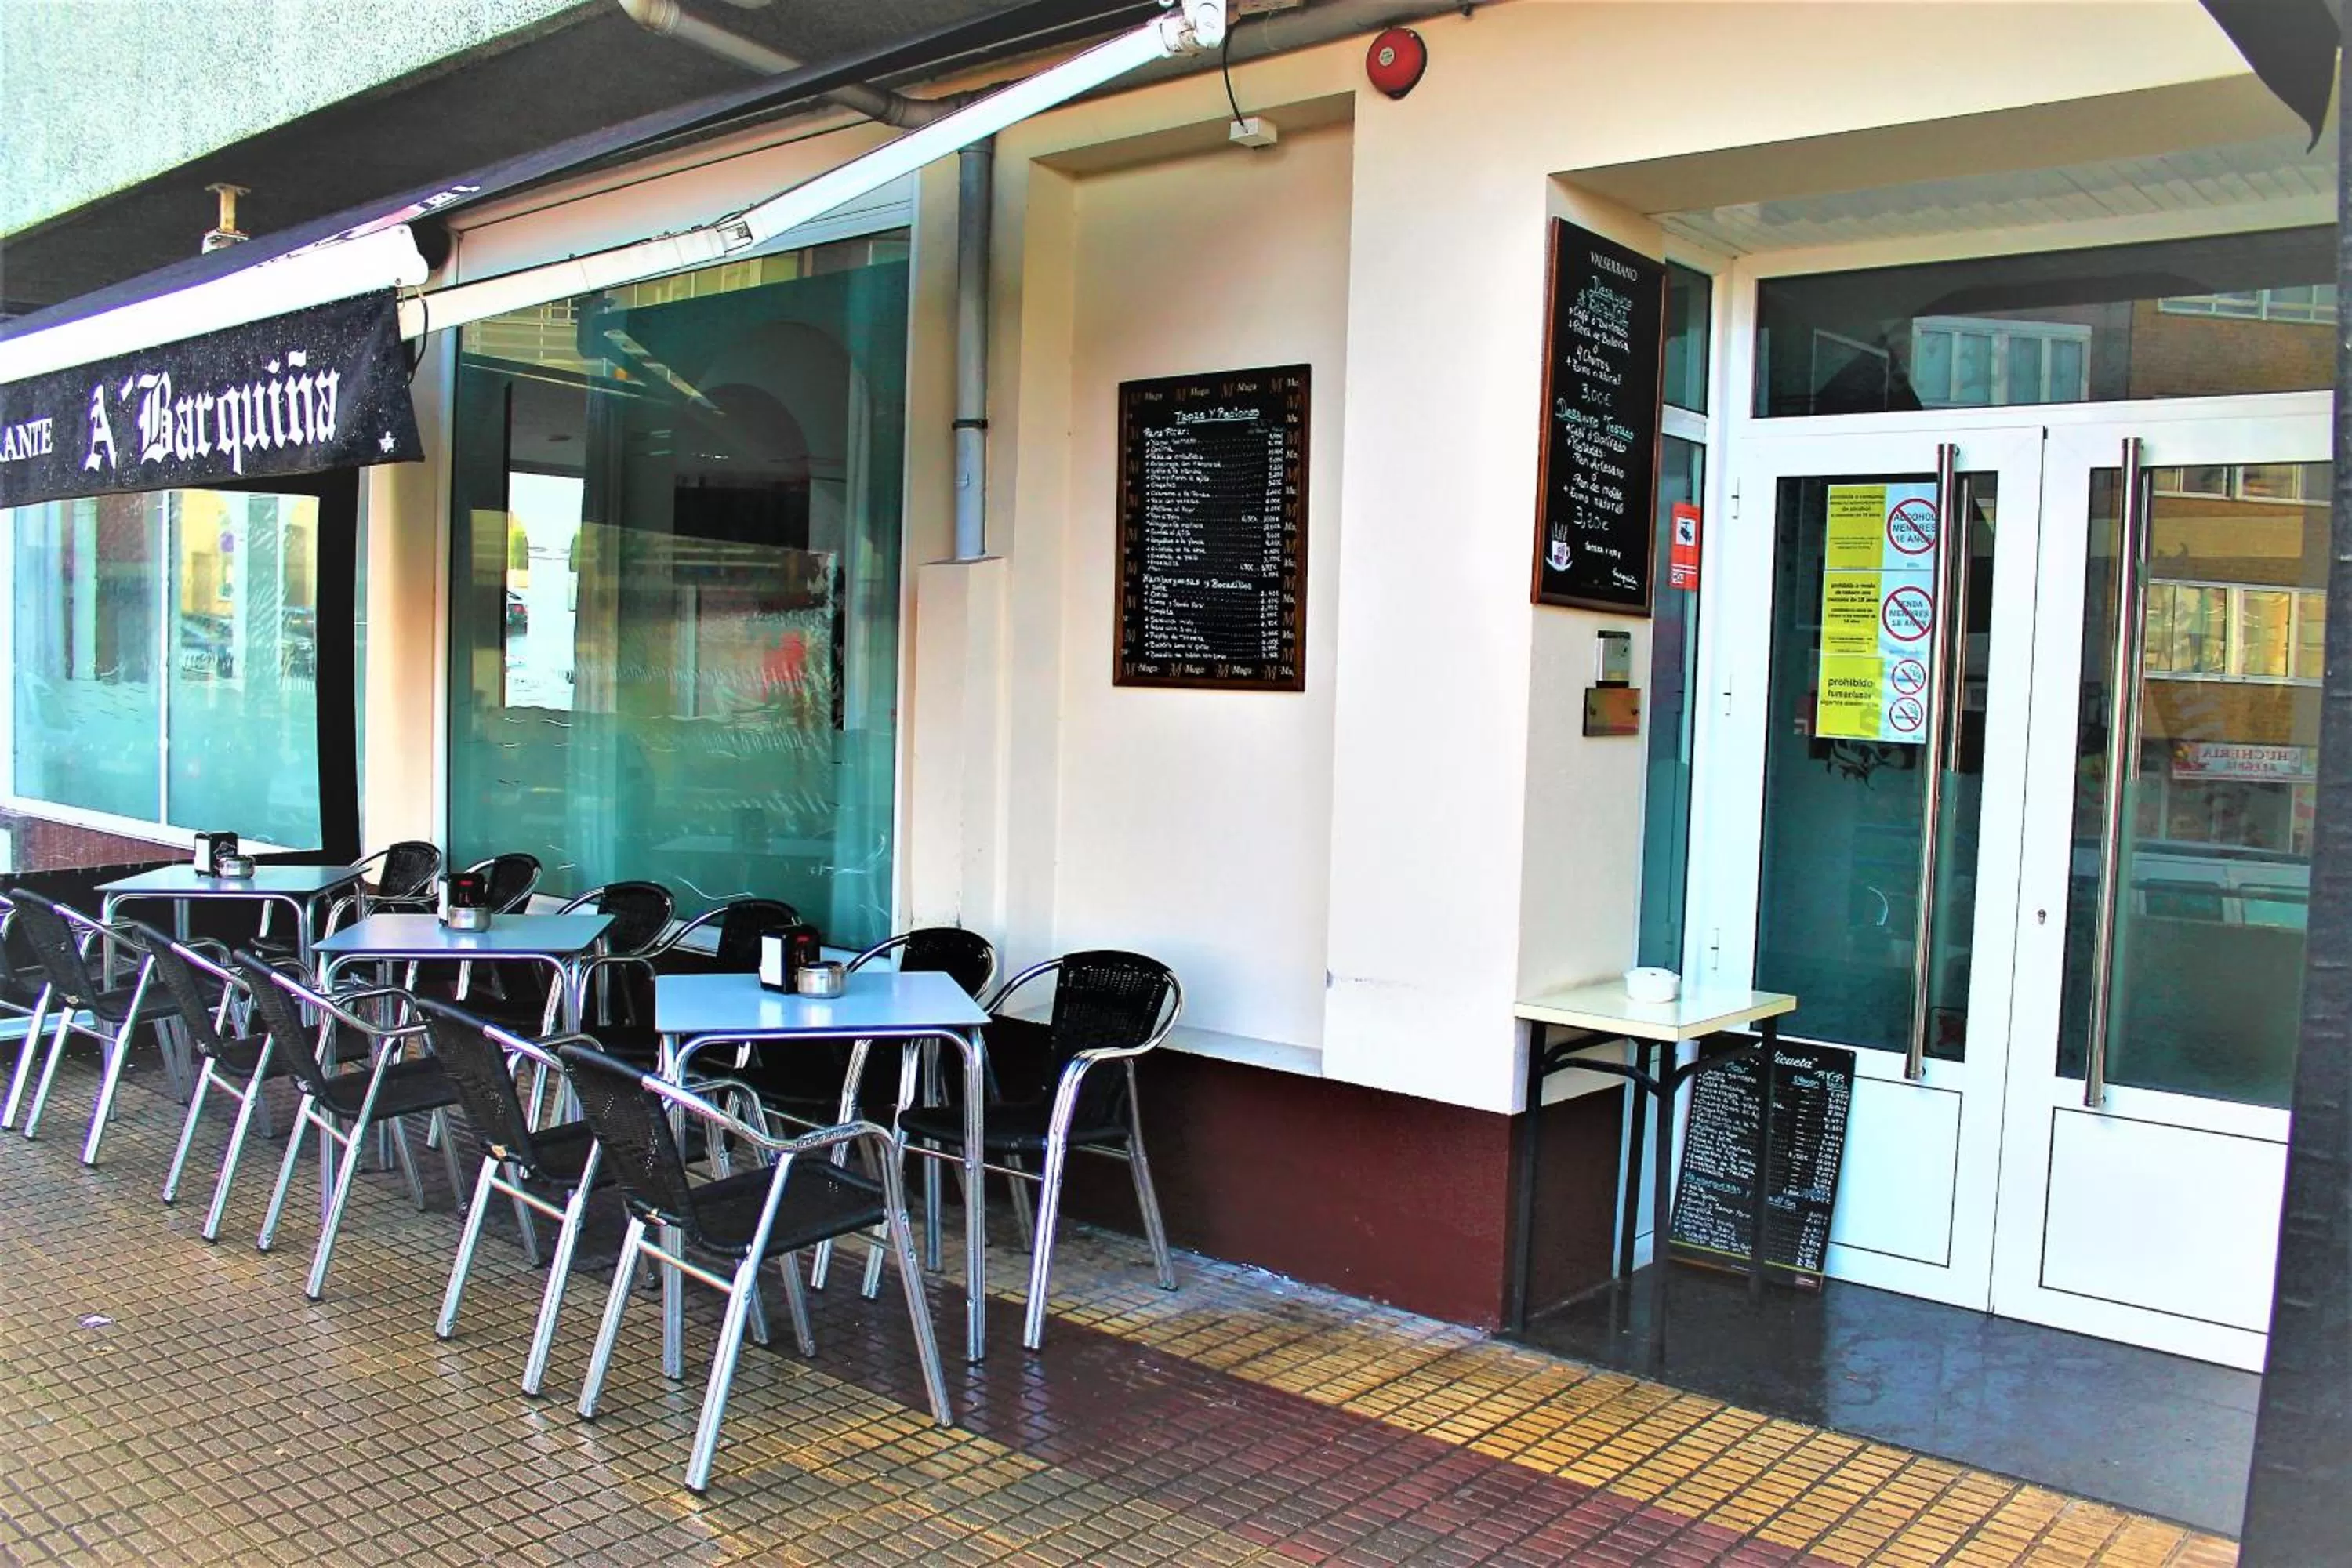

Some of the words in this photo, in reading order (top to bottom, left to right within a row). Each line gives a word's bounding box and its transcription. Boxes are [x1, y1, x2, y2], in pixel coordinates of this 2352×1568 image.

[1589, 251, 1638, 281] VALSERRANO
[137, 349, 342, 476] Barquiña
[1892, 523, 1936, 532] MENRES
[1896, 600, 1923, 608] ENDA
[1889, 609, 1929, 619] MENRES
[1828, 678, 1874, 688] prohibido
